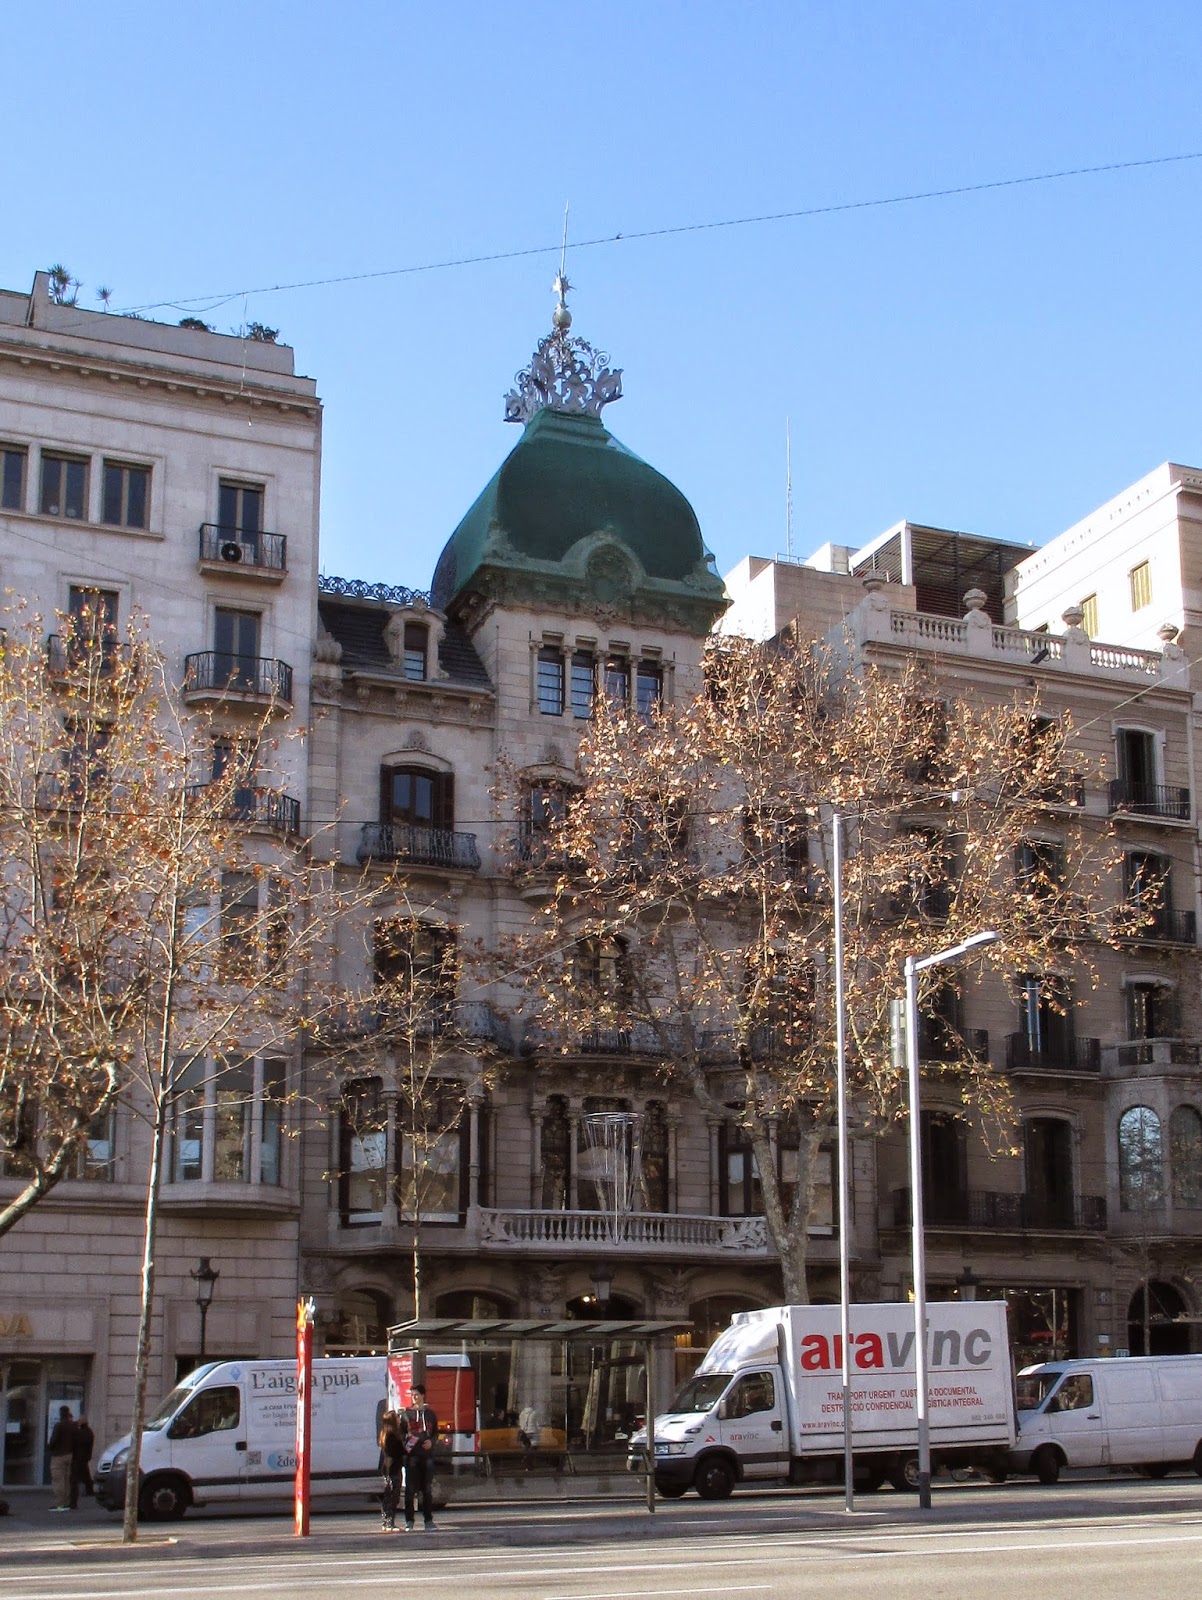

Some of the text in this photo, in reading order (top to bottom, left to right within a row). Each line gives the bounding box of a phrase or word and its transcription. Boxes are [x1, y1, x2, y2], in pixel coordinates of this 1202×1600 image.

[252, 1369, 361, 1393] L'aiga puja
[827, 1386, 977, 1401] TRANPORT URGENT CUSTA DOCUMENTAL
[821, 1401, 864, 1413] DESTRCCIÓ
[865, 1400, 913, 1411] CONFIDENCIAL
[953, 1397, 984, 1407] INTEGRAL
[802, 1420, 854, 1429] www.aravinc.cm
[729, 1431, 760, 1441] aravinc
